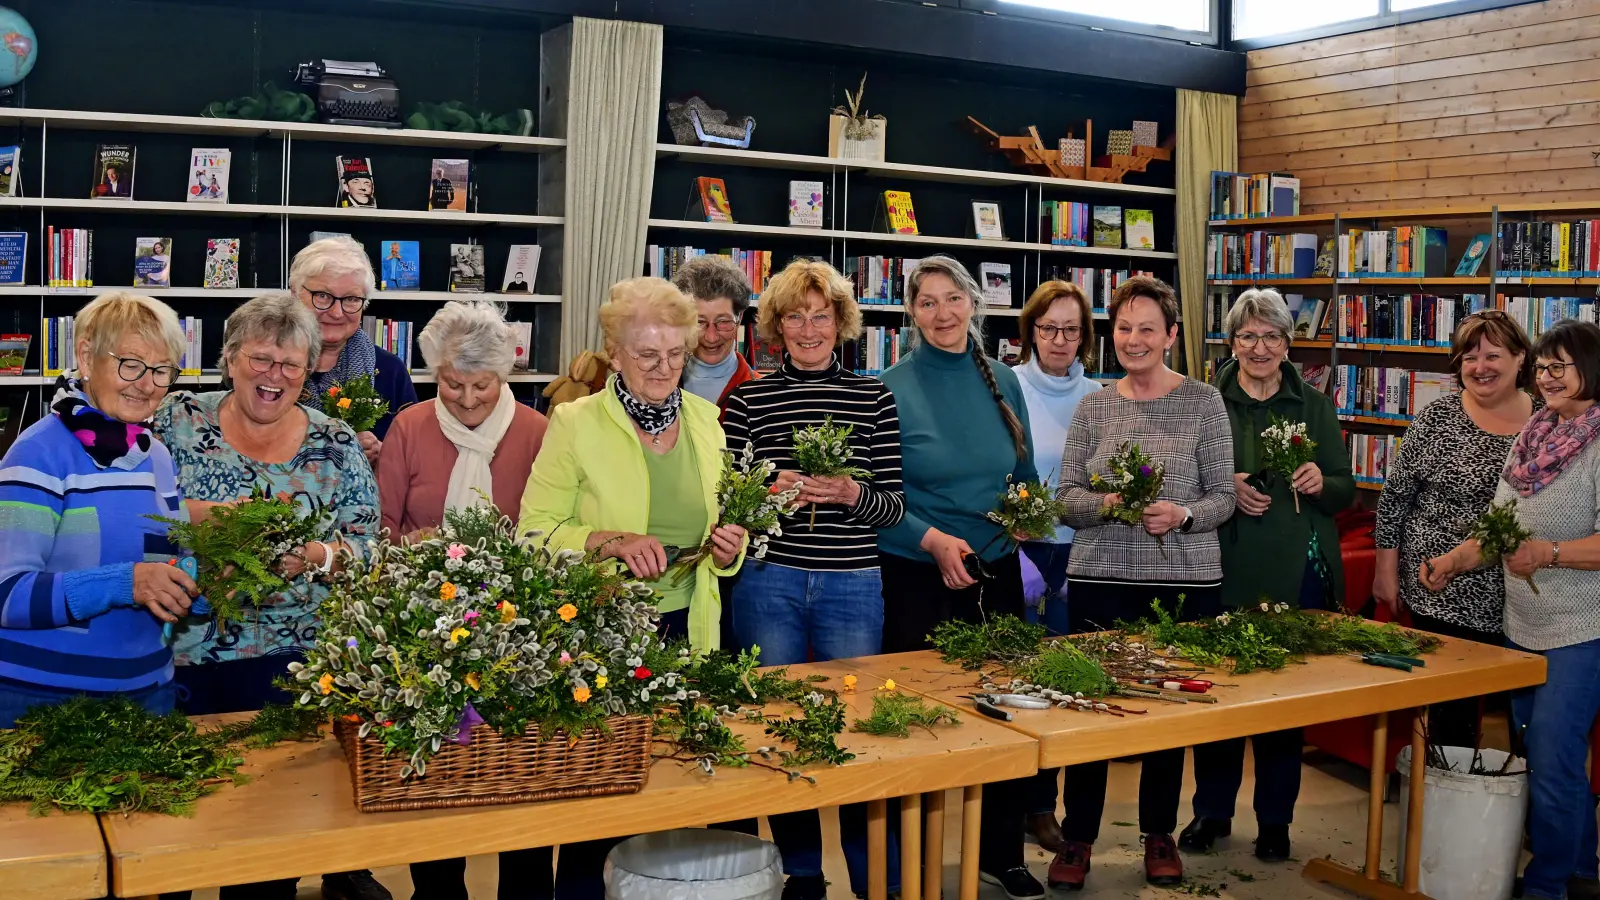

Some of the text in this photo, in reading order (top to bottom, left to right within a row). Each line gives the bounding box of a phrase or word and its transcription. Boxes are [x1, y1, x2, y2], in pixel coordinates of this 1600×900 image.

[100, 150, 130, 158] WUNDER
[1513, 244, 1521, 264] LINK
[1523, 244, 1531, 264] LINK
[762, 354, 774, 362] Der
